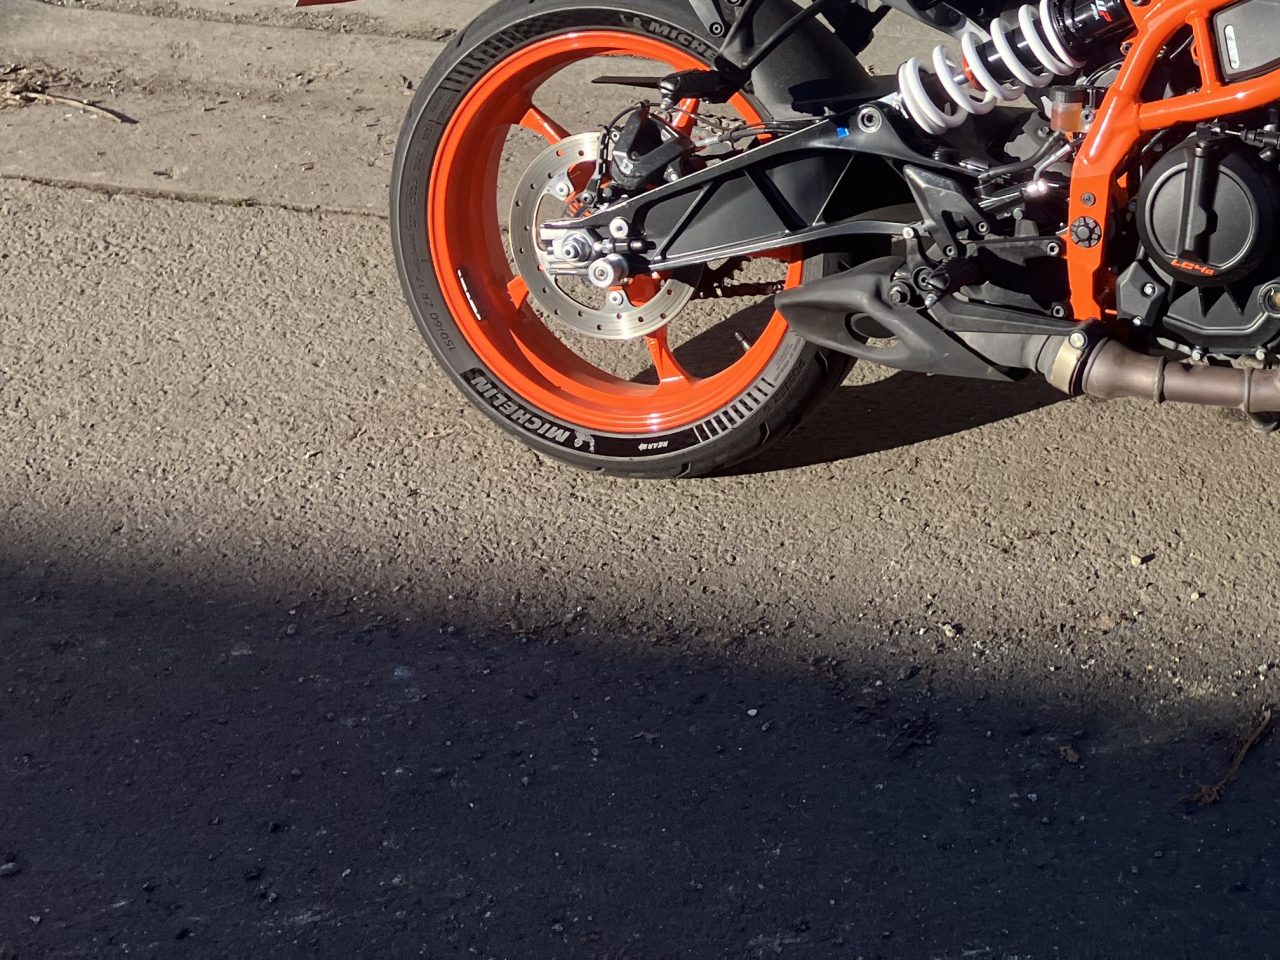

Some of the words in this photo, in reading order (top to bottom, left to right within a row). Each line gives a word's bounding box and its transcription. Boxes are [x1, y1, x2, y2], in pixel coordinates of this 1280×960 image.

[648, 21, 718, 60] MICHE
[470, 376, 572, 443] MICHELIN
[647, 440, 669, 450] REAR
